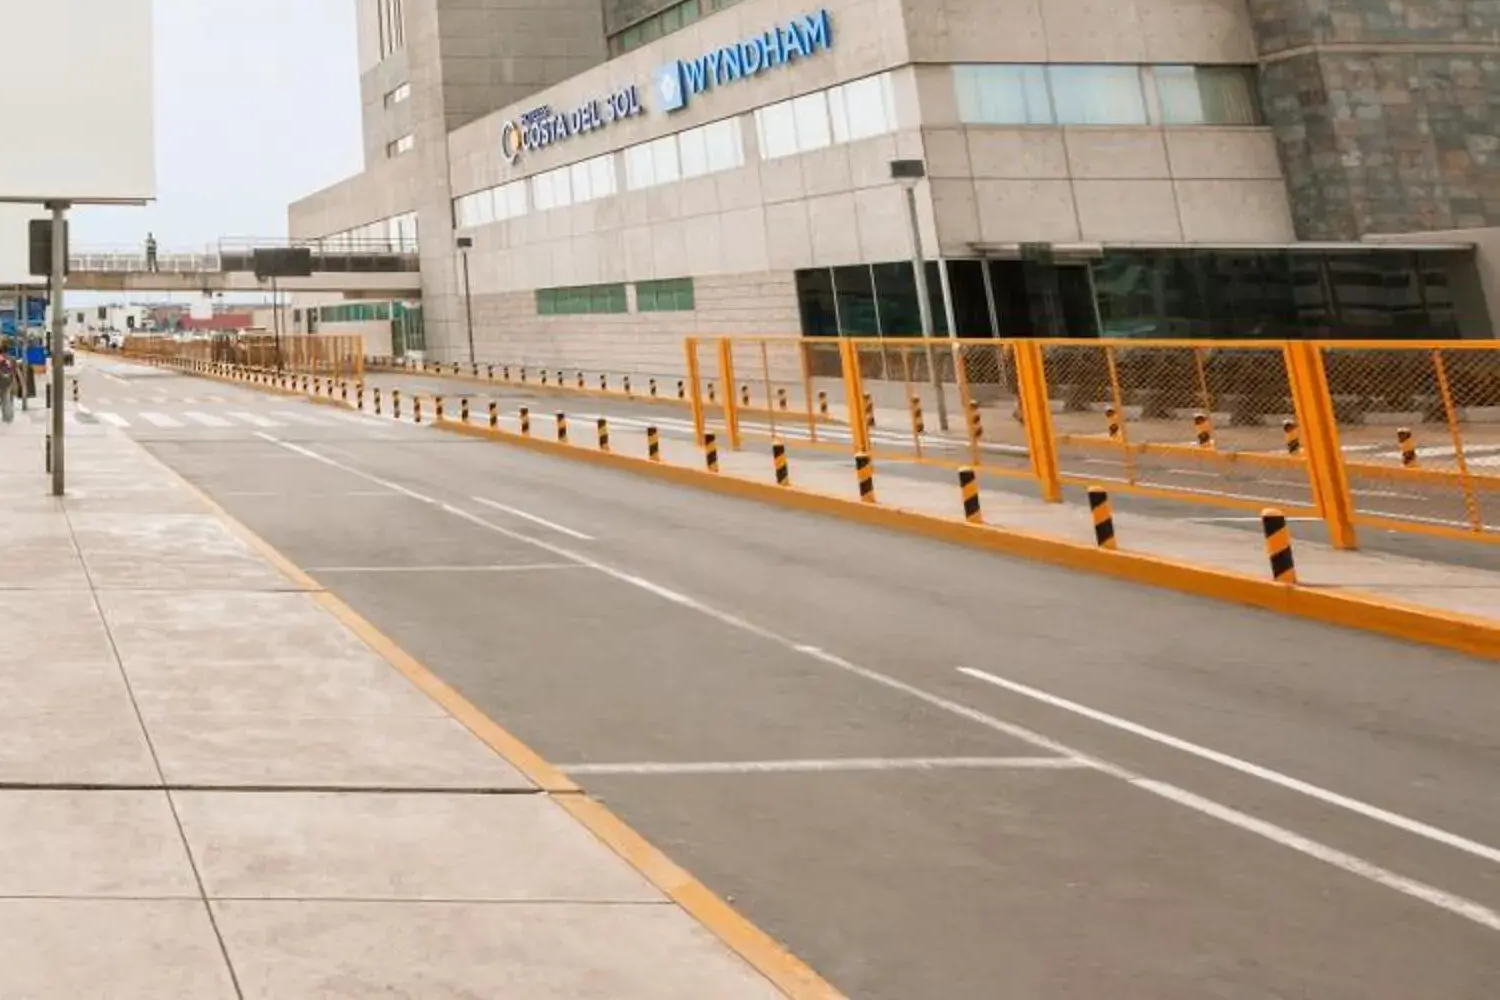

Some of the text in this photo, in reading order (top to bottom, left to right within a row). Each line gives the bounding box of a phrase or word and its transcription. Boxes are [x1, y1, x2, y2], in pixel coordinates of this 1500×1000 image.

[683, 8, 833, 94] WYNDHAM
[521, 113, 570, 151] COSTA
[571, 99, 605, 135] DEL
[605, 84, 645, 122] SOL
